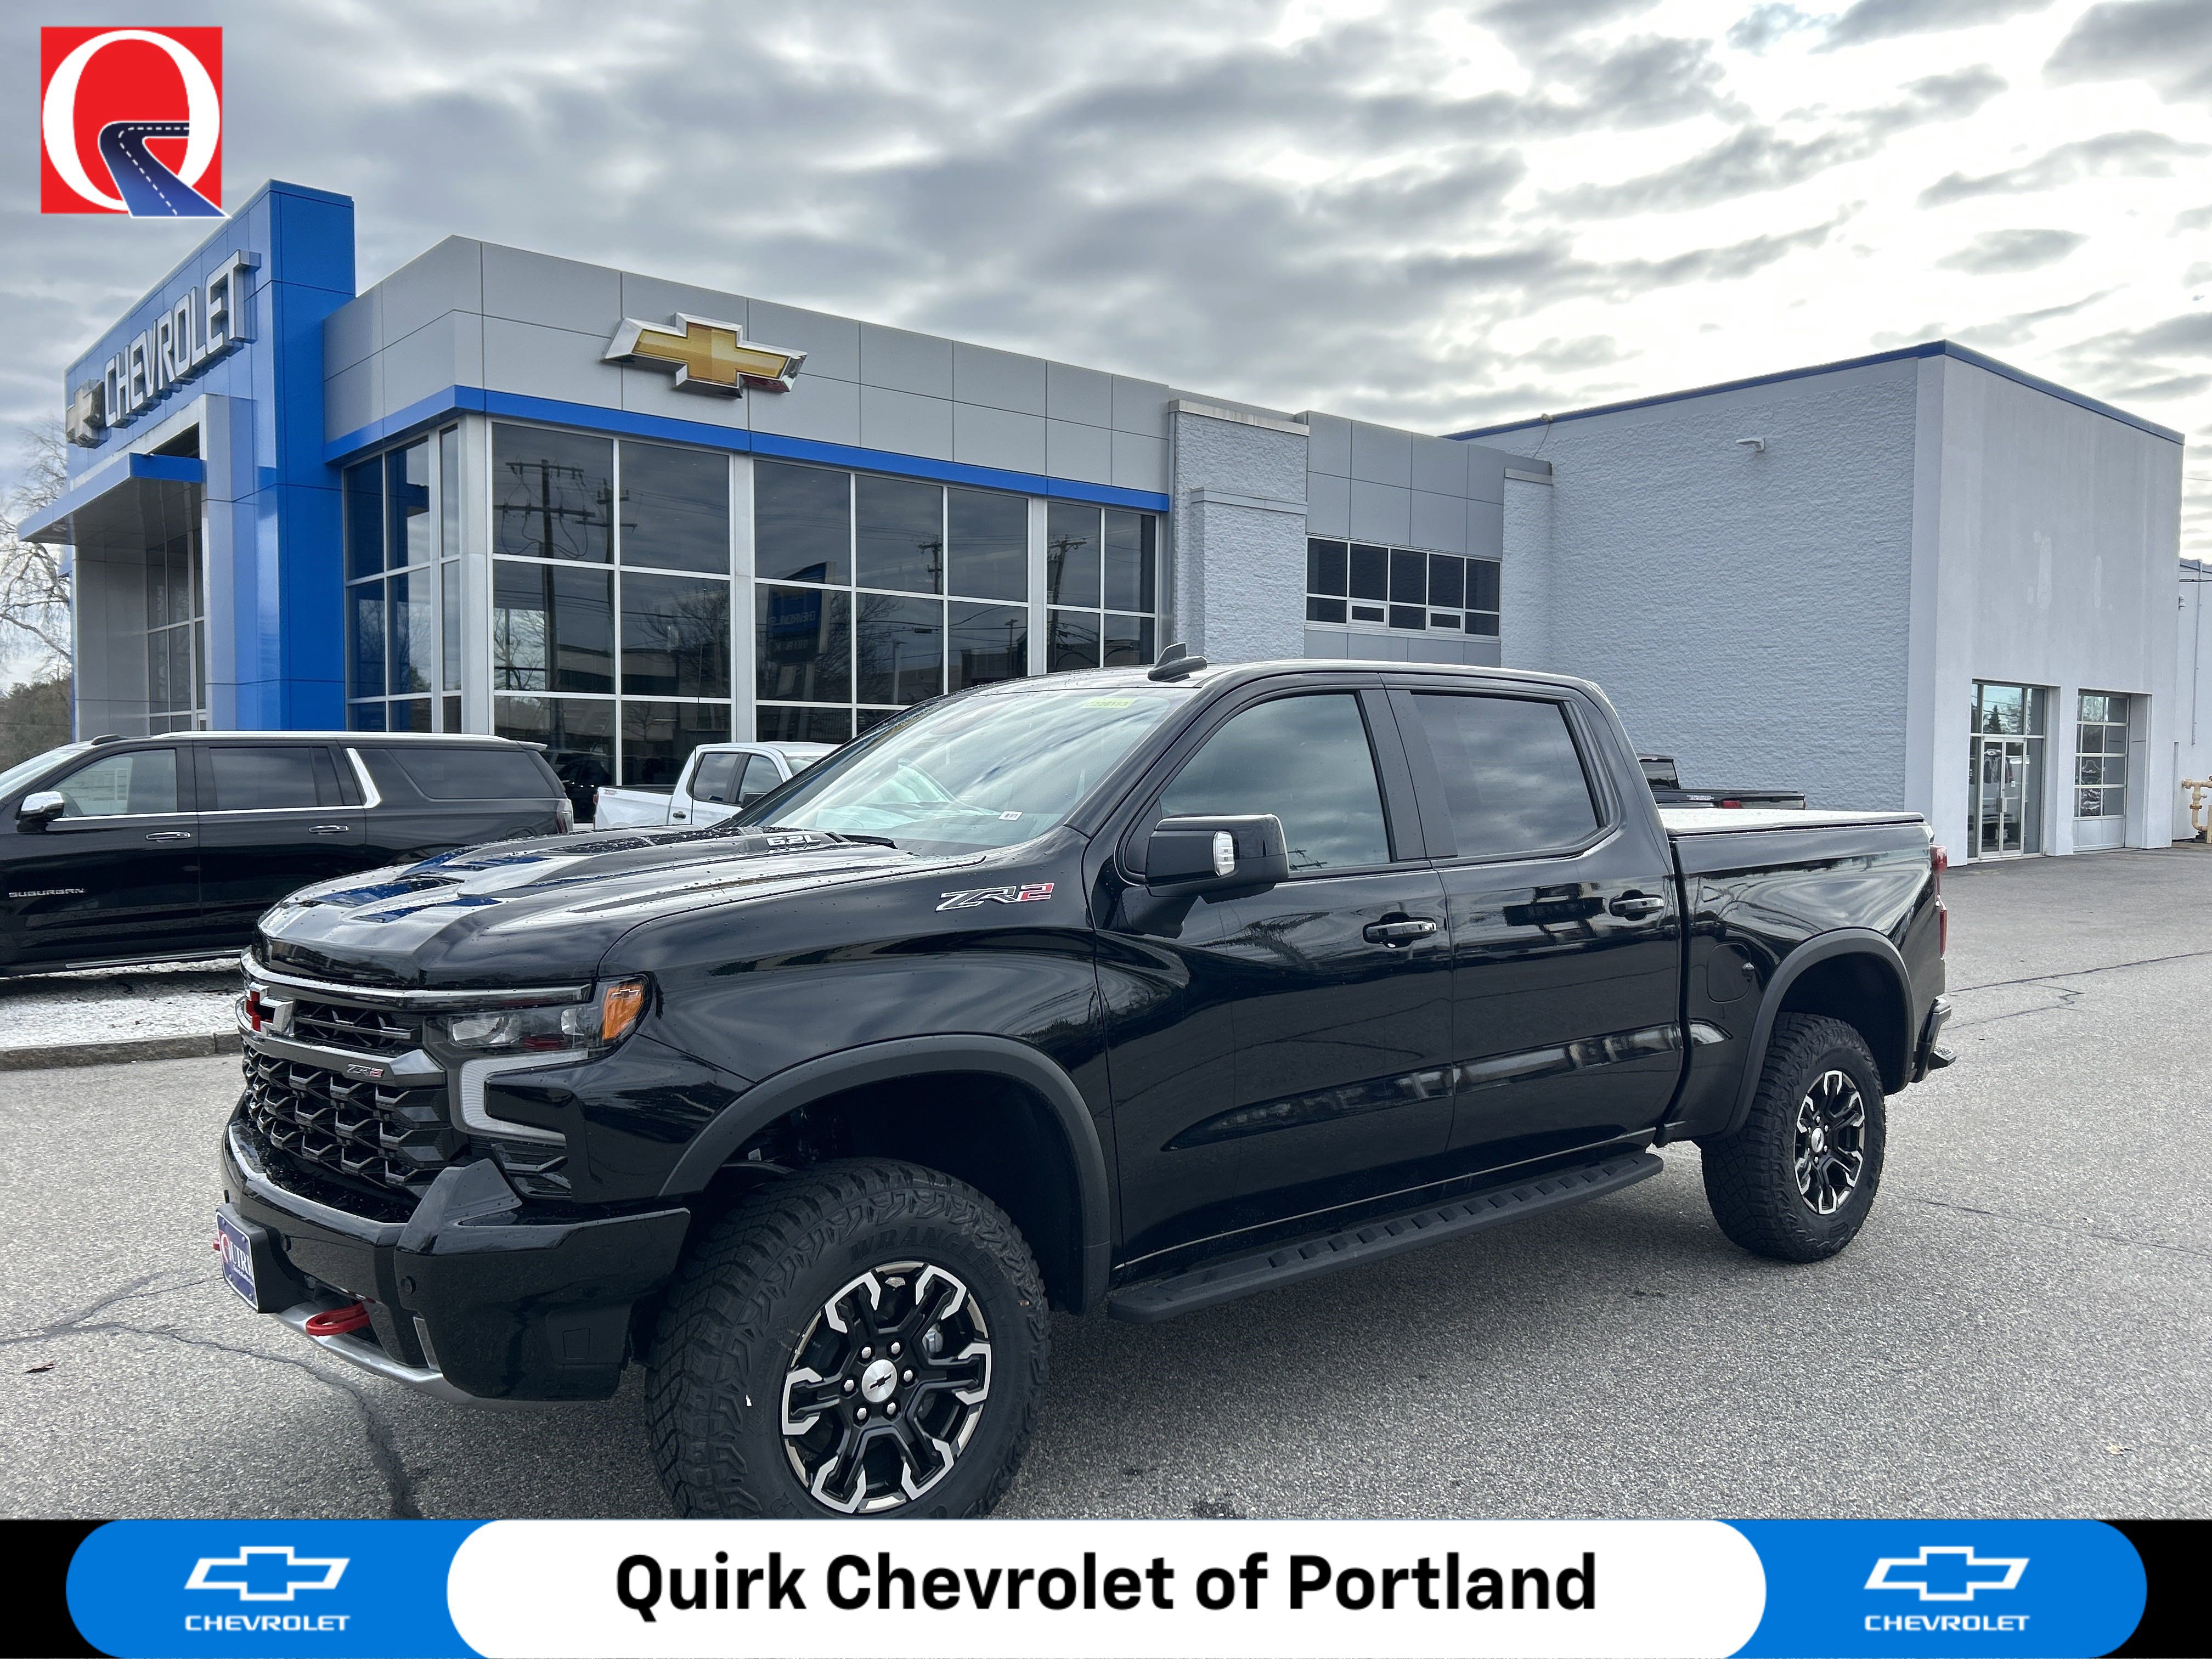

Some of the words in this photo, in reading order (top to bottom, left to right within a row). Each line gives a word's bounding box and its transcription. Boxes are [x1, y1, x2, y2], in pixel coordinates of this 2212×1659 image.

[104, 249, 259, 428] CHEVROLET
[8, 888, 86, 898] SUBURBAN
[935, 882, 1054, 912] ZR2
[347, 1064, 384, 1079] ZR2
[850, 1225, 1001, 1290] WRANGLER
